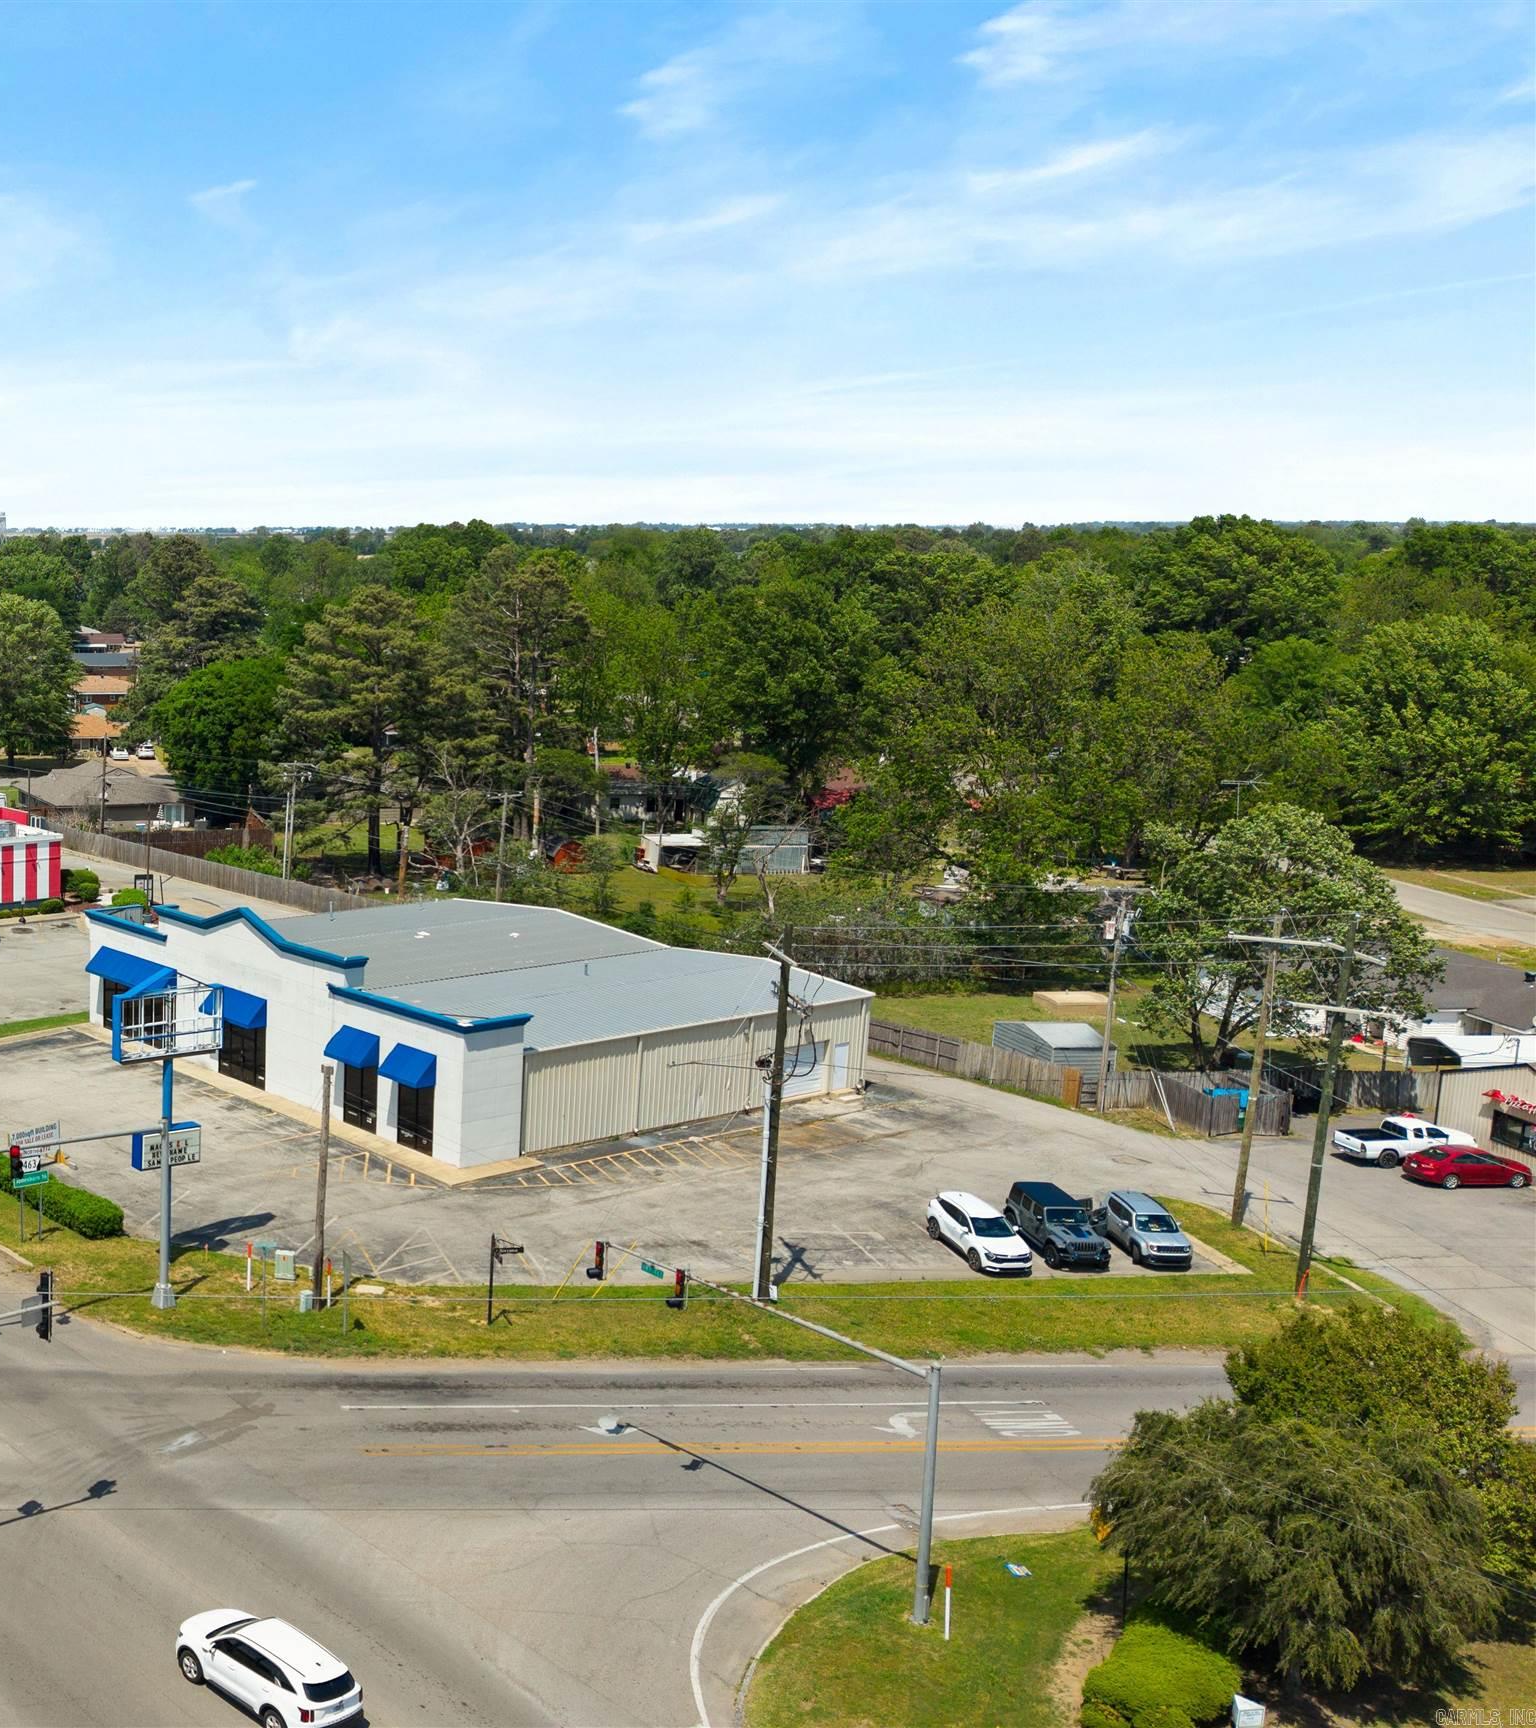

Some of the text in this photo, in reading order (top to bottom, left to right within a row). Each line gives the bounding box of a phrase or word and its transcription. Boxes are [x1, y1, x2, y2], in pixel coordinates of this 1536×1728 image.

[170, 1147, 187, 1155] NAME
[170, 1153, 195, 1163] PEOPLE
[970, 1409, 1082, 1437] ONLY
